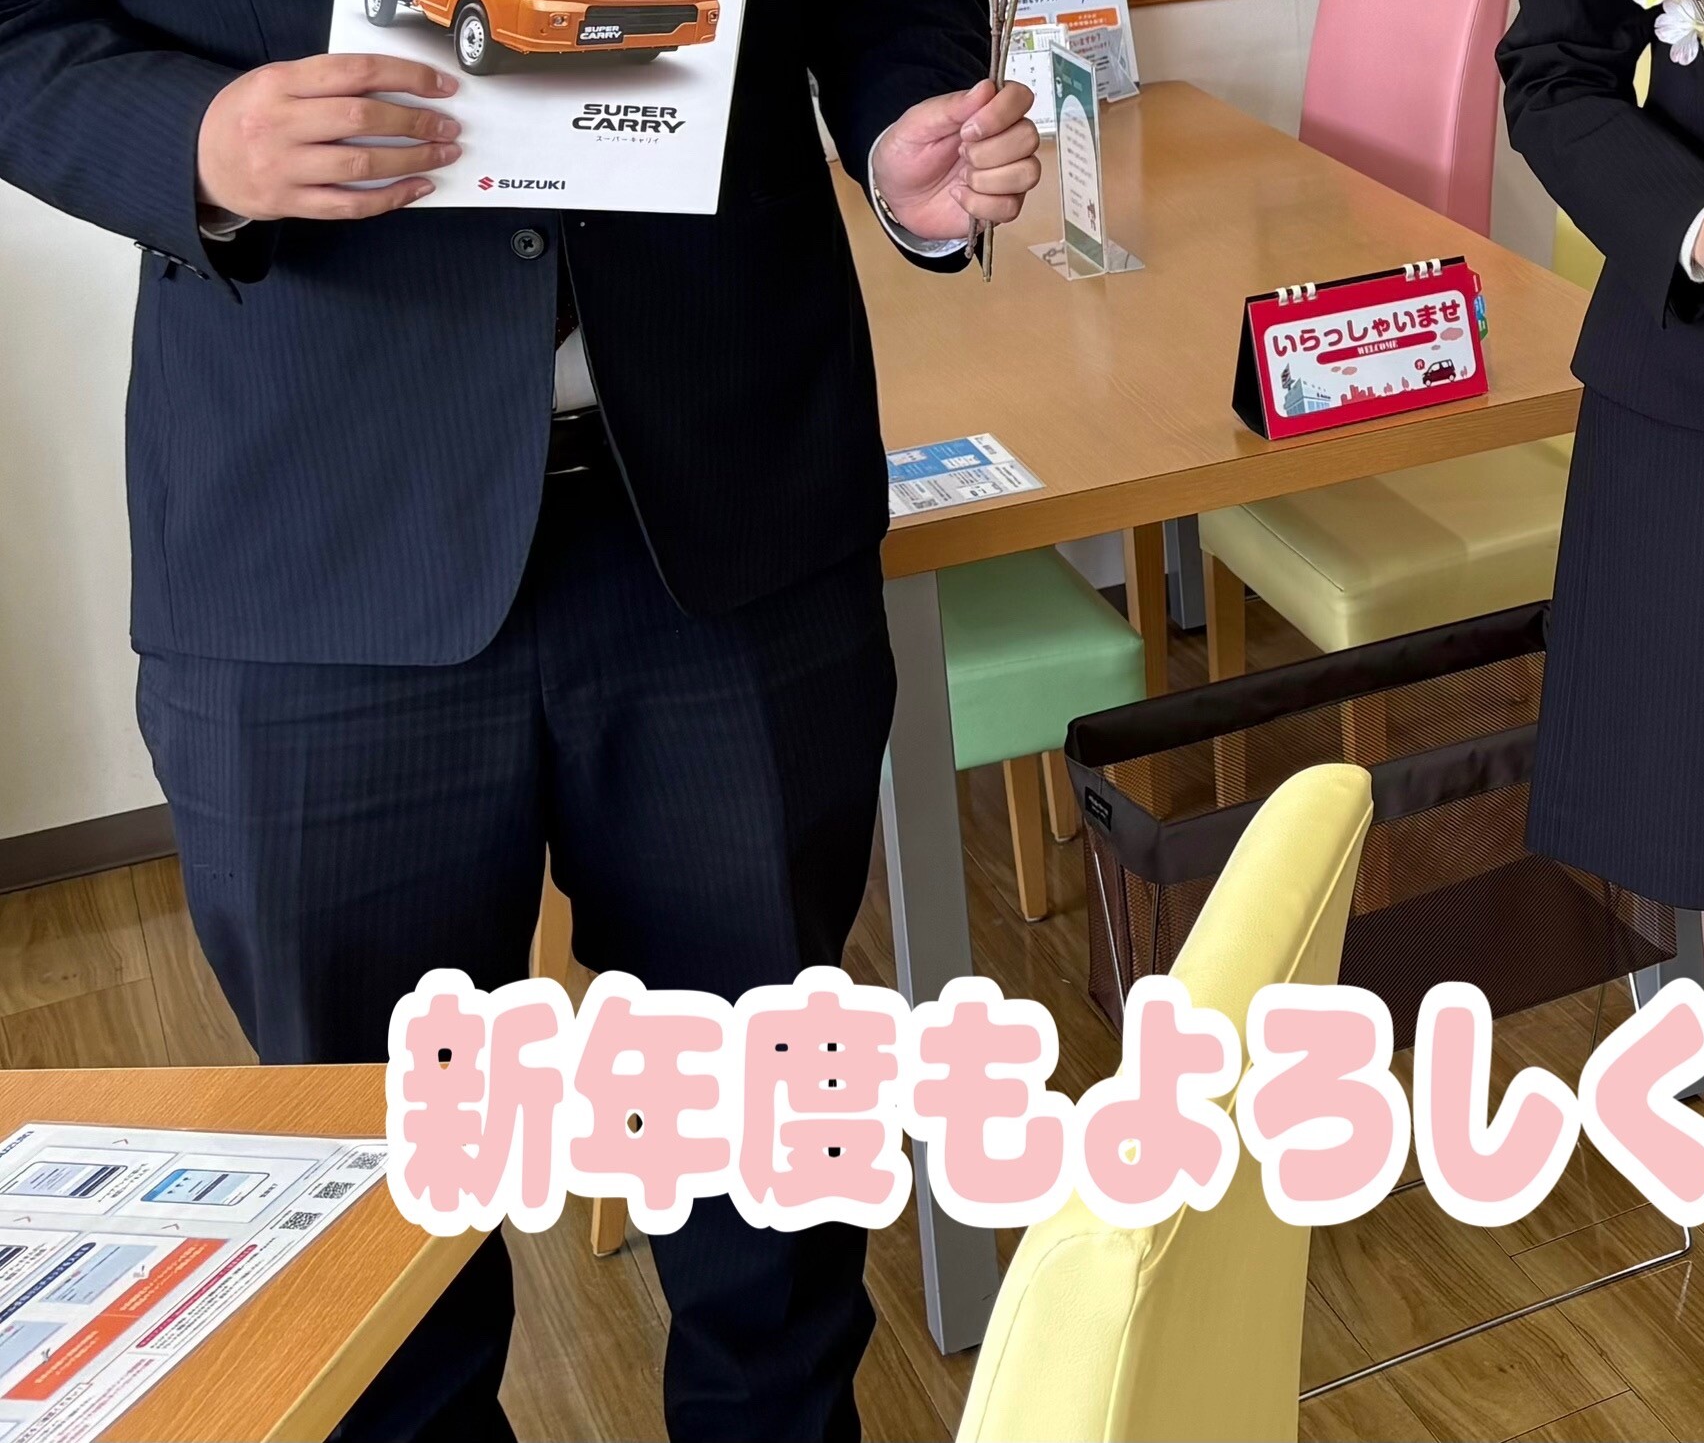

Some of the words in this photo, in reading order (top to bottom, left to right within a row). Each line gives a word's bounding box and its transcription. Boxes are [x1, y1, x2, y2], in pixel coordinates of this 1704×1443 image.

[579, 31, 622, 40] CARRY
[584, 25, 620, 33] SUPER
[583, 103, 678, 119] SUPER
[572, 117, 686, 134] CARRY
[596, 135, 660, 145] スーパーキャリイ
[497, 179, 566, 191] SUZUKI
[1272, 299, 1461, 357] いらっしゃいませ
[1357, 339, 1399, 356] WELCOME
